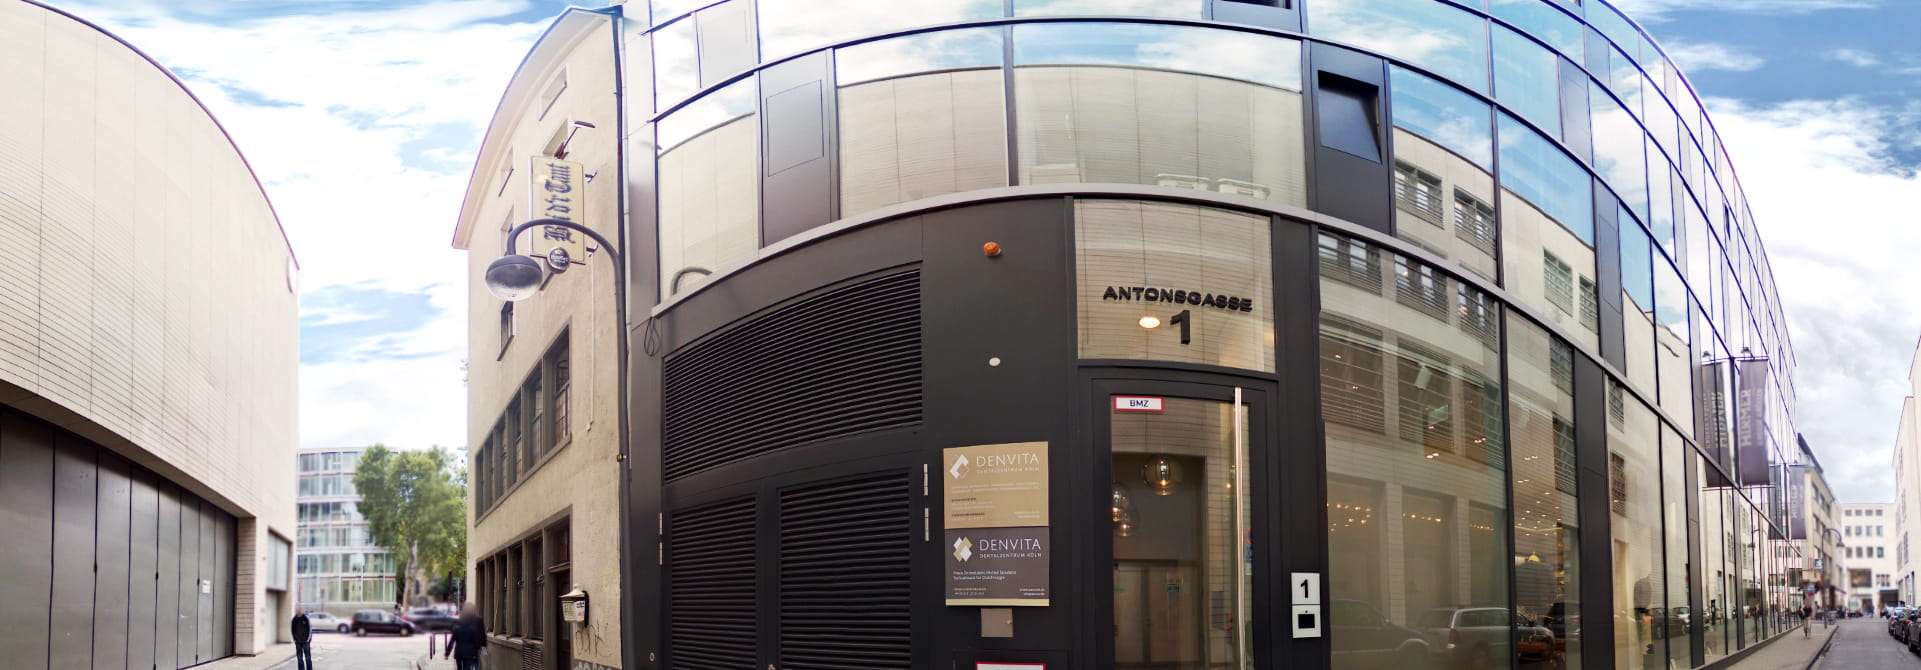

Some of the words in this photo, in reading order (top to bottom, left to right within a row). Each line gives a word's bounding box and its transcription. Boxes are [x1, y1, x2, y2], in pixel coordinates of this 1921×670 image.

[544, 213, 576, 244] Bi
[1103, 286, 1253, 312] ANTONSGASSE
[1170, 309, 1191, 345] 1
[1129, 399, 1150, 408] BMZ
[976, 453, 1040, 467] DENVITA
[979, 538, 1041, 551] DENVITA
[1300, 579, 1309, 599] 1
